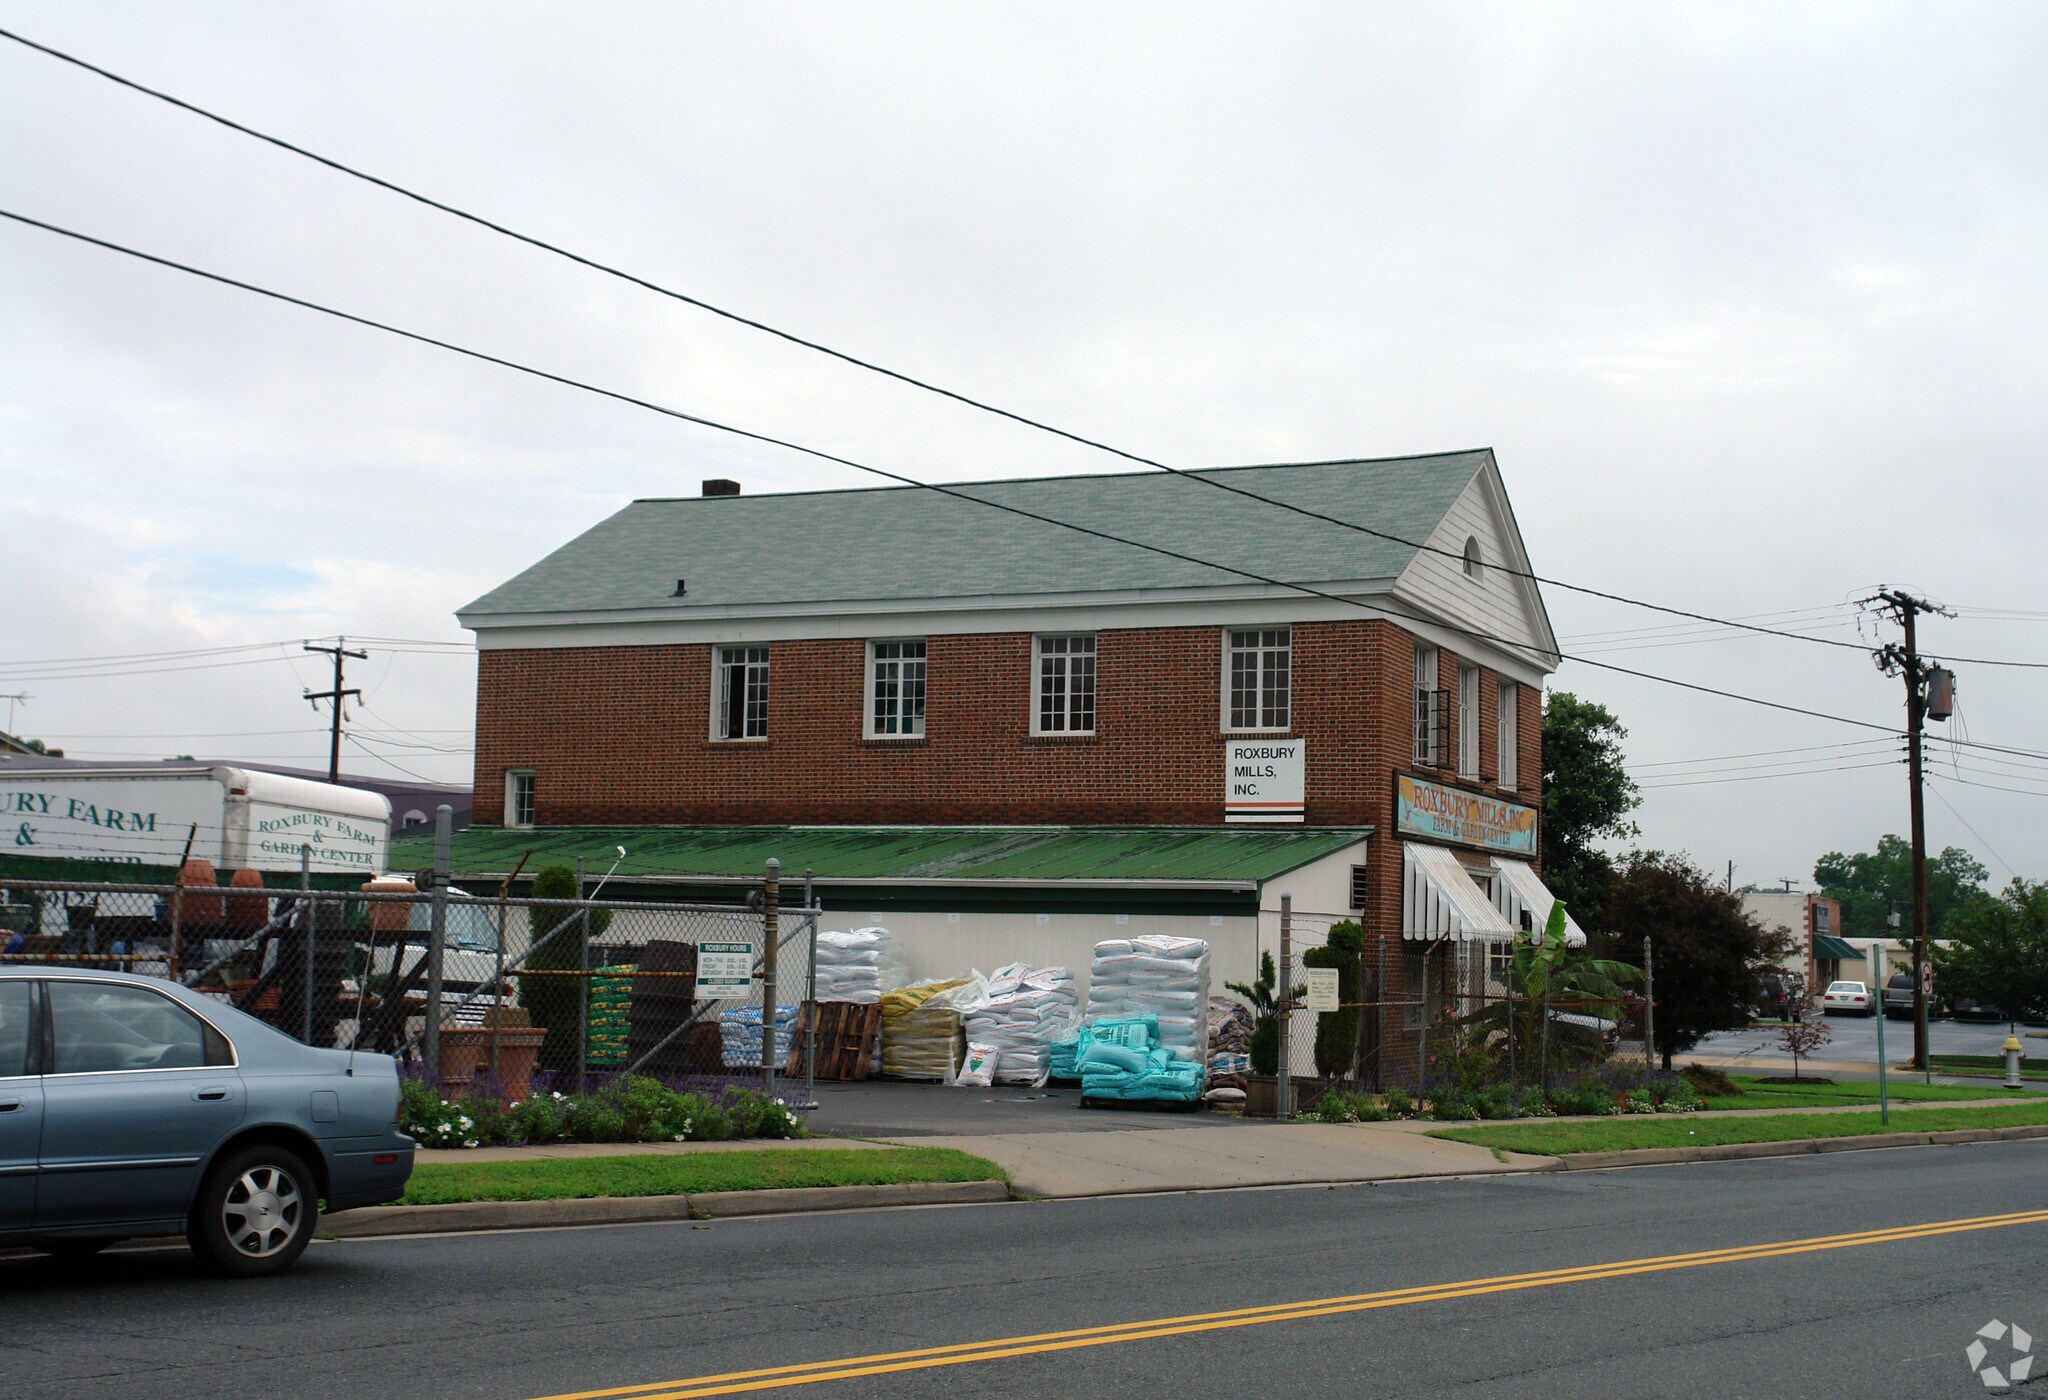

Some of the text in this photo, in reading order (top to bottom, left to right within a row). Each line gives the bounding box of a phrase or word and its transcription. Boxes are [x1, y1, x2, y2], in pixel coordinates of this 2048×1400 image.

[1234, 747, 1296, 760] ROXBURY
[1234, 765, 1277, 779] MILLS,
[1234, 783, 1260, 796] INC.
[1413, 784, 1473, 819] ROXBURY
[66, 797, 158, 832] FARM
[15, 821, 37, 846] &
[259, 813, 376, 846] ROXBURY FARM
[312, 829, 324, 843] &
[1453, 821, 1460, 837] &
[1461, 823, 1486, 841] GARDEN
[1487, 825, 1512, 846] CENTER
[261, 840, 373, 865] GARDN CENTER
[704, 944, 747, 952] ROXBURY HOURS
